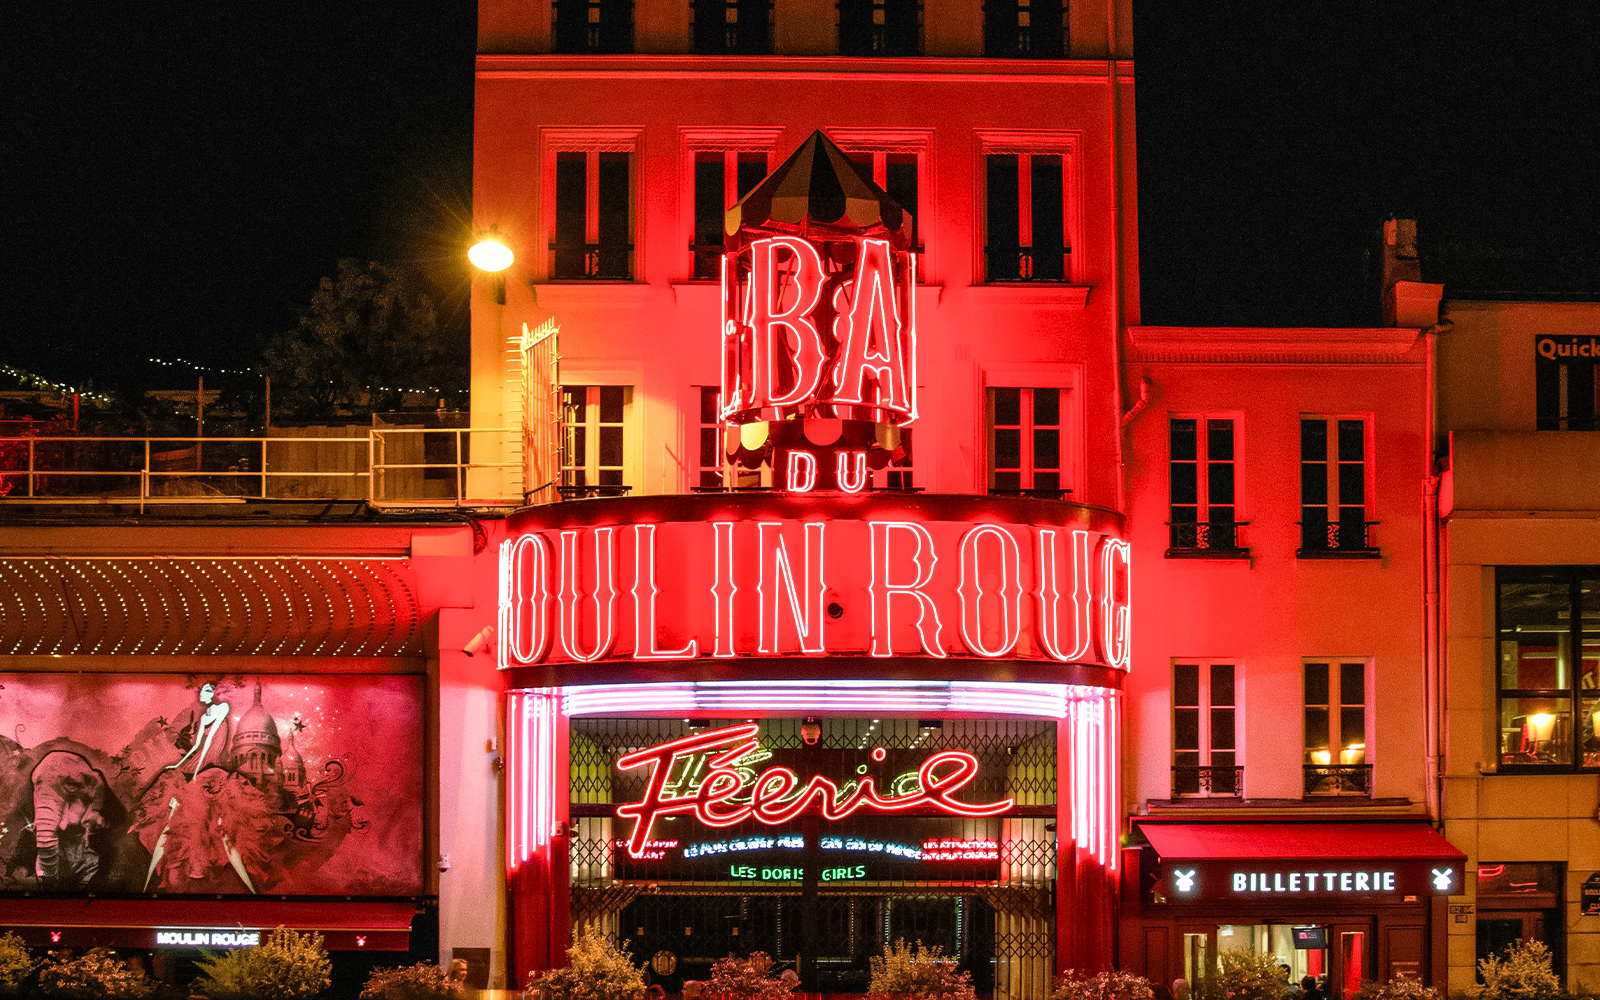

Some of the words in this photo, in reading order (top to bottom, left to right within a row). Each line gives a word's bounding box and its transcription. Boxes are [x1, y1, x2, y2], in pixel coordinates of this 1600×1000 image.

[1537, 337, 1600, 361] Quick
[787, 451, 868, 493] DU
[497, 521, 827, 669] OULIN
[617, 723, 1014, 855] Féerie
[730, 865, 757, 879] LES
[762, 867, 804, 880] DORIS
[822, 866, 866, 881] GIRLS
[1233, 871, 1397, 892] BILLETTERIE
[156, 932, 210, 946] MOULIN
[212, 932, 260, 946] ROUGE
